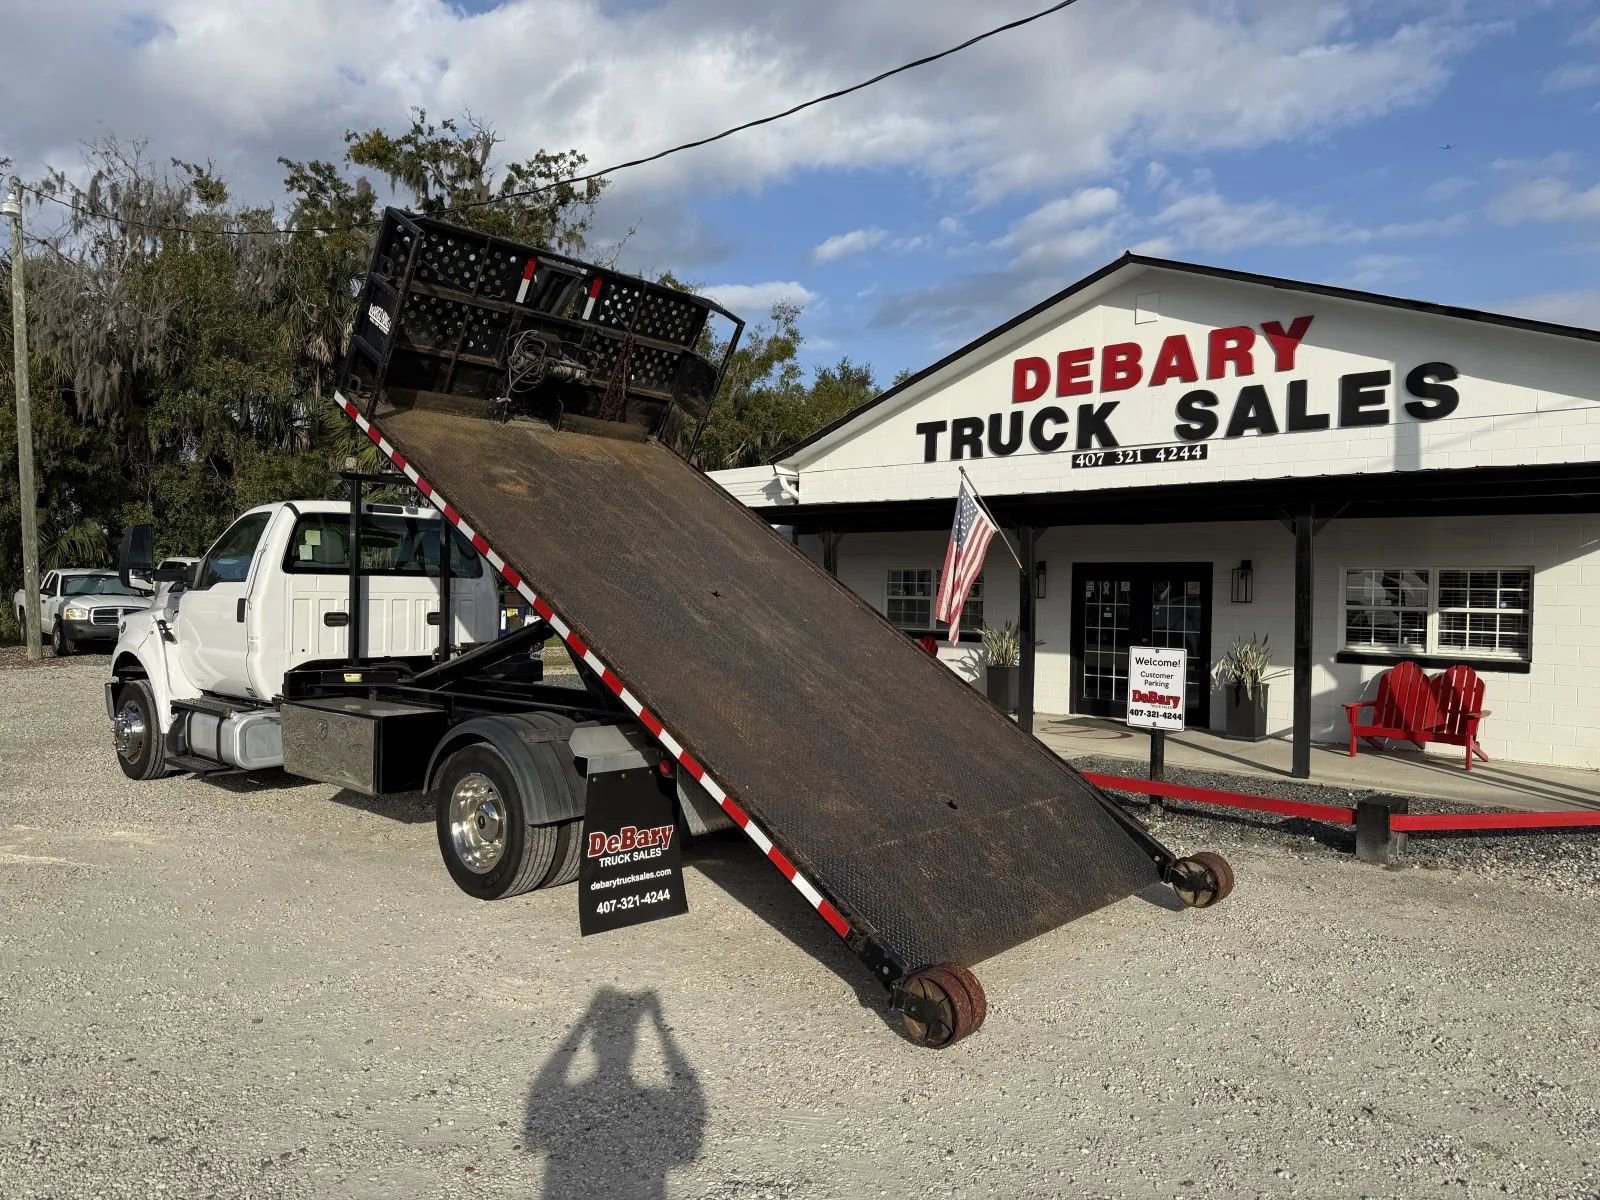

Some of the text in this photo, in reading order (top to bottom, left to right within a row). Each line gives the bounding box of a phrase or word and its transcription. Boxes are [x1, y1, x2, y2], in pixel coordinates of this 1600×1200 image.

[1012, 314, 1315, 404] DEBARY
[916, 361, 1460, 463] TRUCK SALES
[1075, 444, 1202, 468] 407 321 4244
[1134, 656, 1181, 668] Welcome!
[1140, 670, 1174, 680] Customer
[1144, 679, 1170, 689] Parking
[1132, 690, 1181, 709] DeBary
[1129, 708, 1182, 721] 407-321-4244
[587, 825, 674, 858] DeBary
[599, 847, 662, 868] TRUCK SALES
[590, 868, 672, 891] debarytrucksales.com
[596, 888, 671, 915] 407-321-4244
